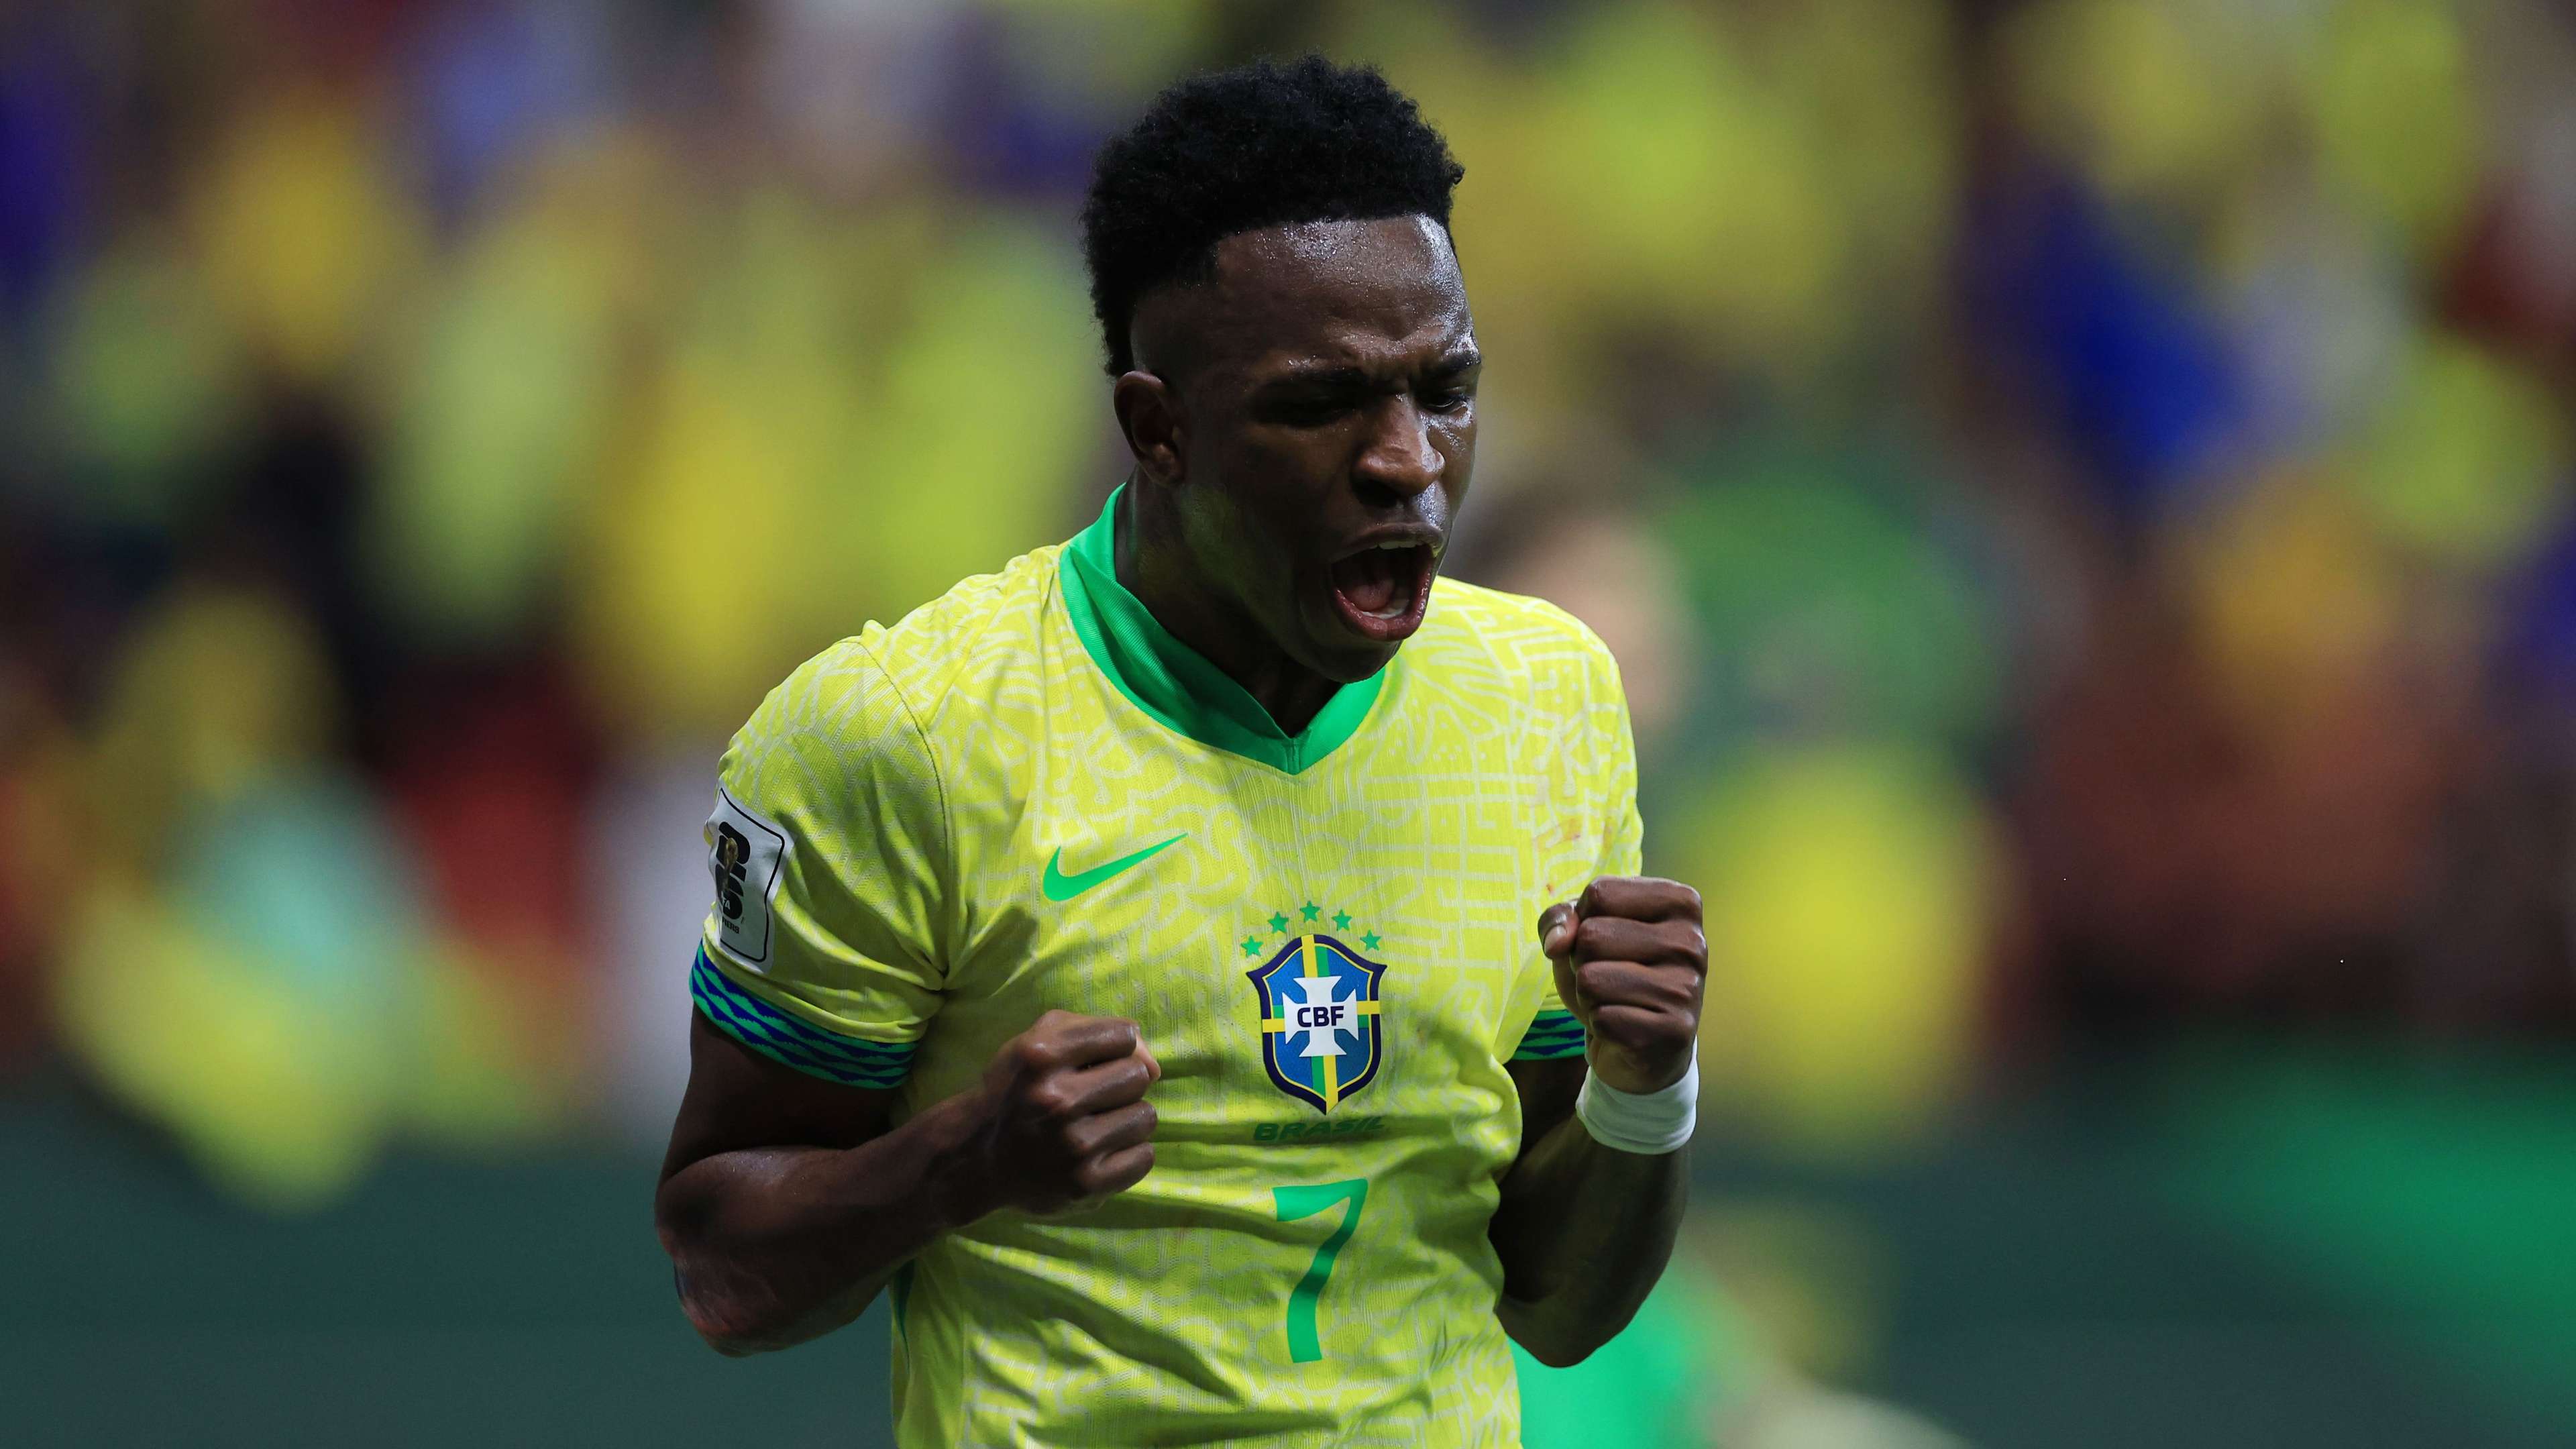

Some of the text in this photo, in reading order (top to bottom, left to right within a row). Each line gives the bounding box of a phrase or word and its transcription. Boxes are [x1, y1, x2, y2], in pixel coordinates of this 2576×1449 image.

[1297, 1006, 1345, 1028] CBF
[1254, 1116, 1385, 1141] BRASIL
[1273, 1179, 1368, 1363] 7
